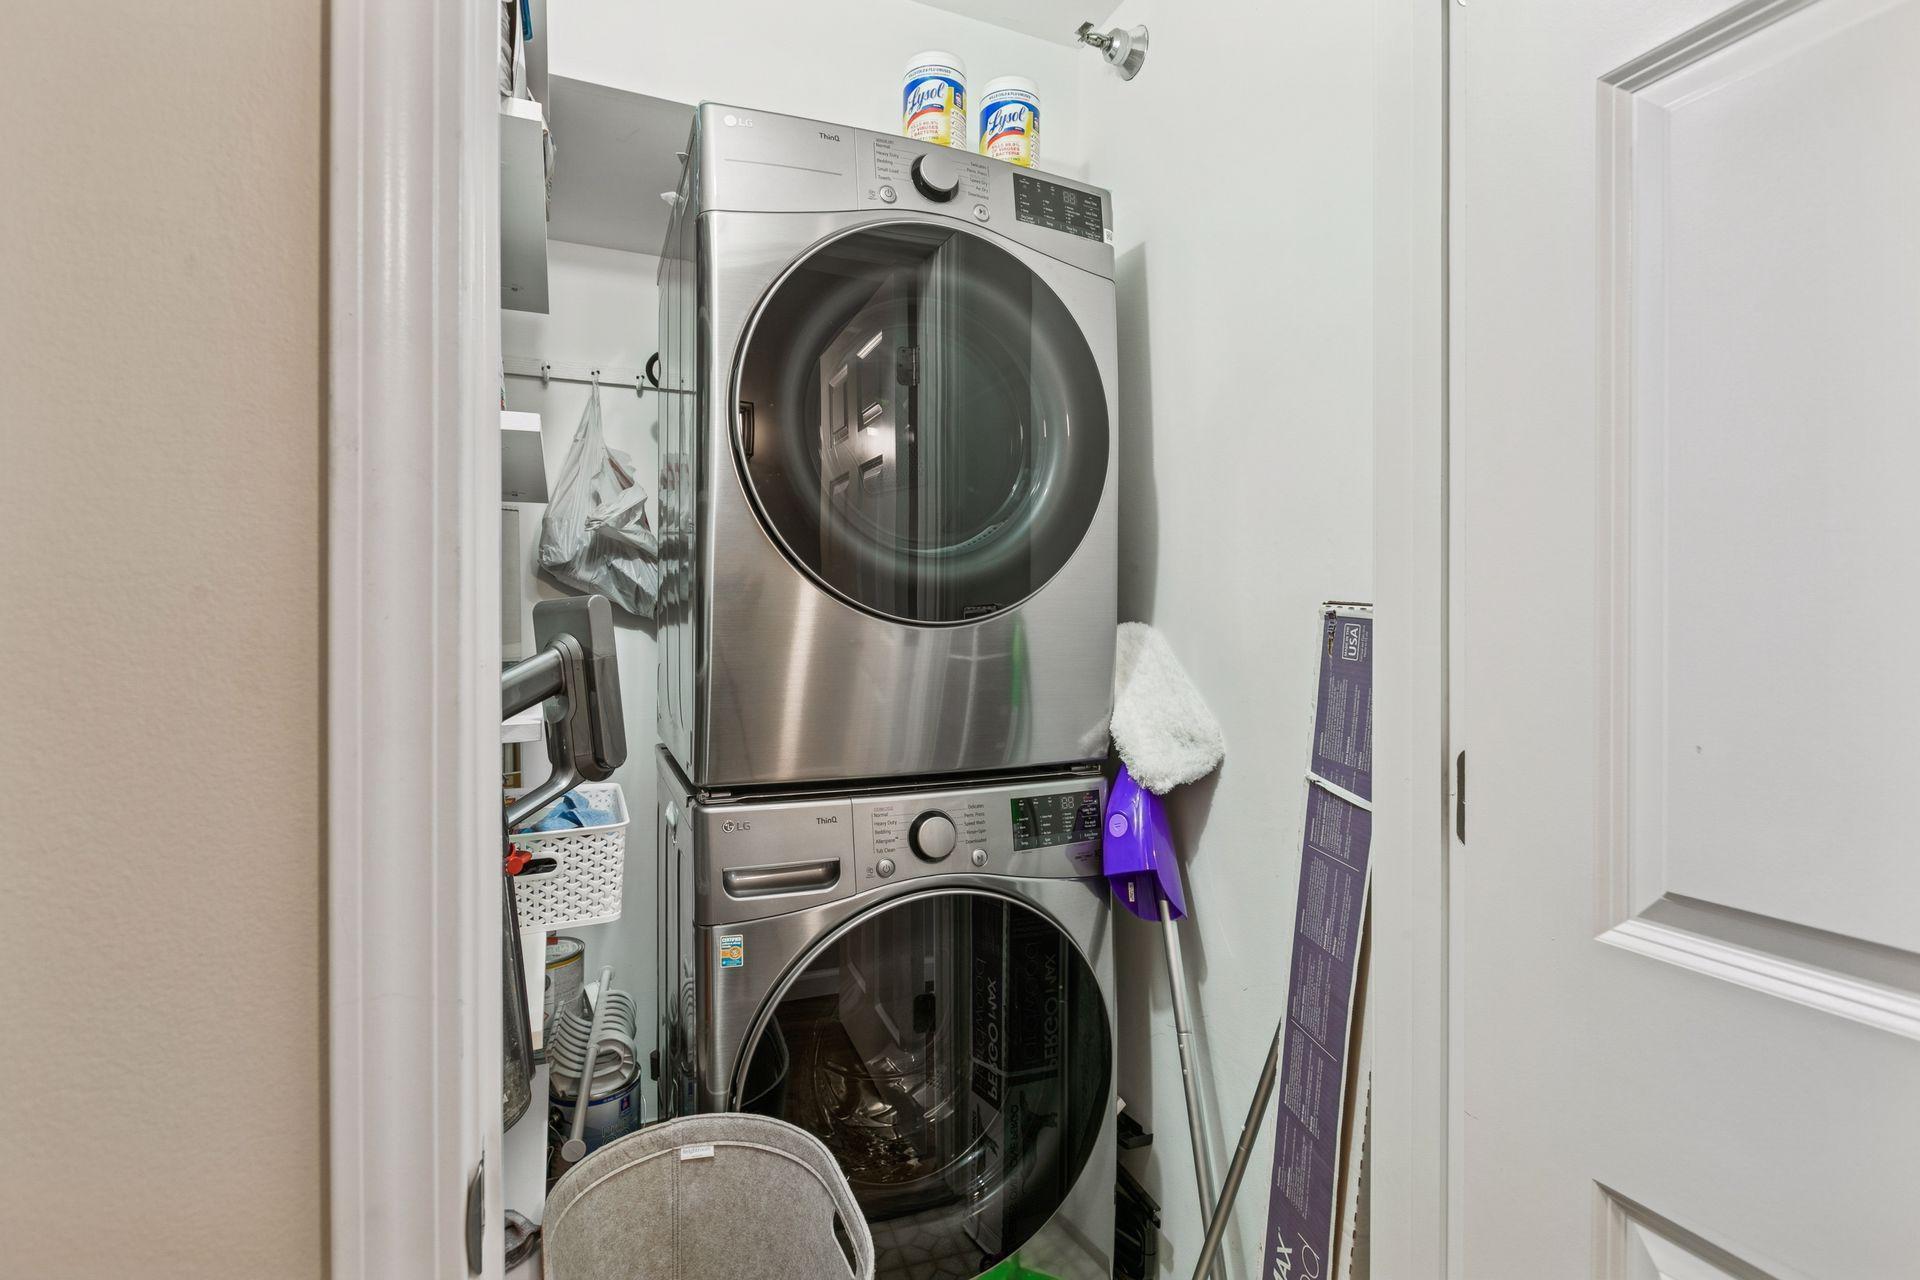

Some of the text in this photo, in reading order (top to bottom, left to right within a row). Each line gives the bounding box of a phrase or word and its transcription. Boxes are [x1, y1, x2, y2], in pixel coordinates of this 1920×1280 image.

[908, 82, 945, 115] Lysol
[738, 118, 753, 128] LG
[988, 106, 1026, 135] Lysol
[819, 132, 841, 142] ThinQ
[1348, 628, 1358, 656] USA
[816, 816, 837, 826] ThinQ
[737, 822, 751, 831] LG
